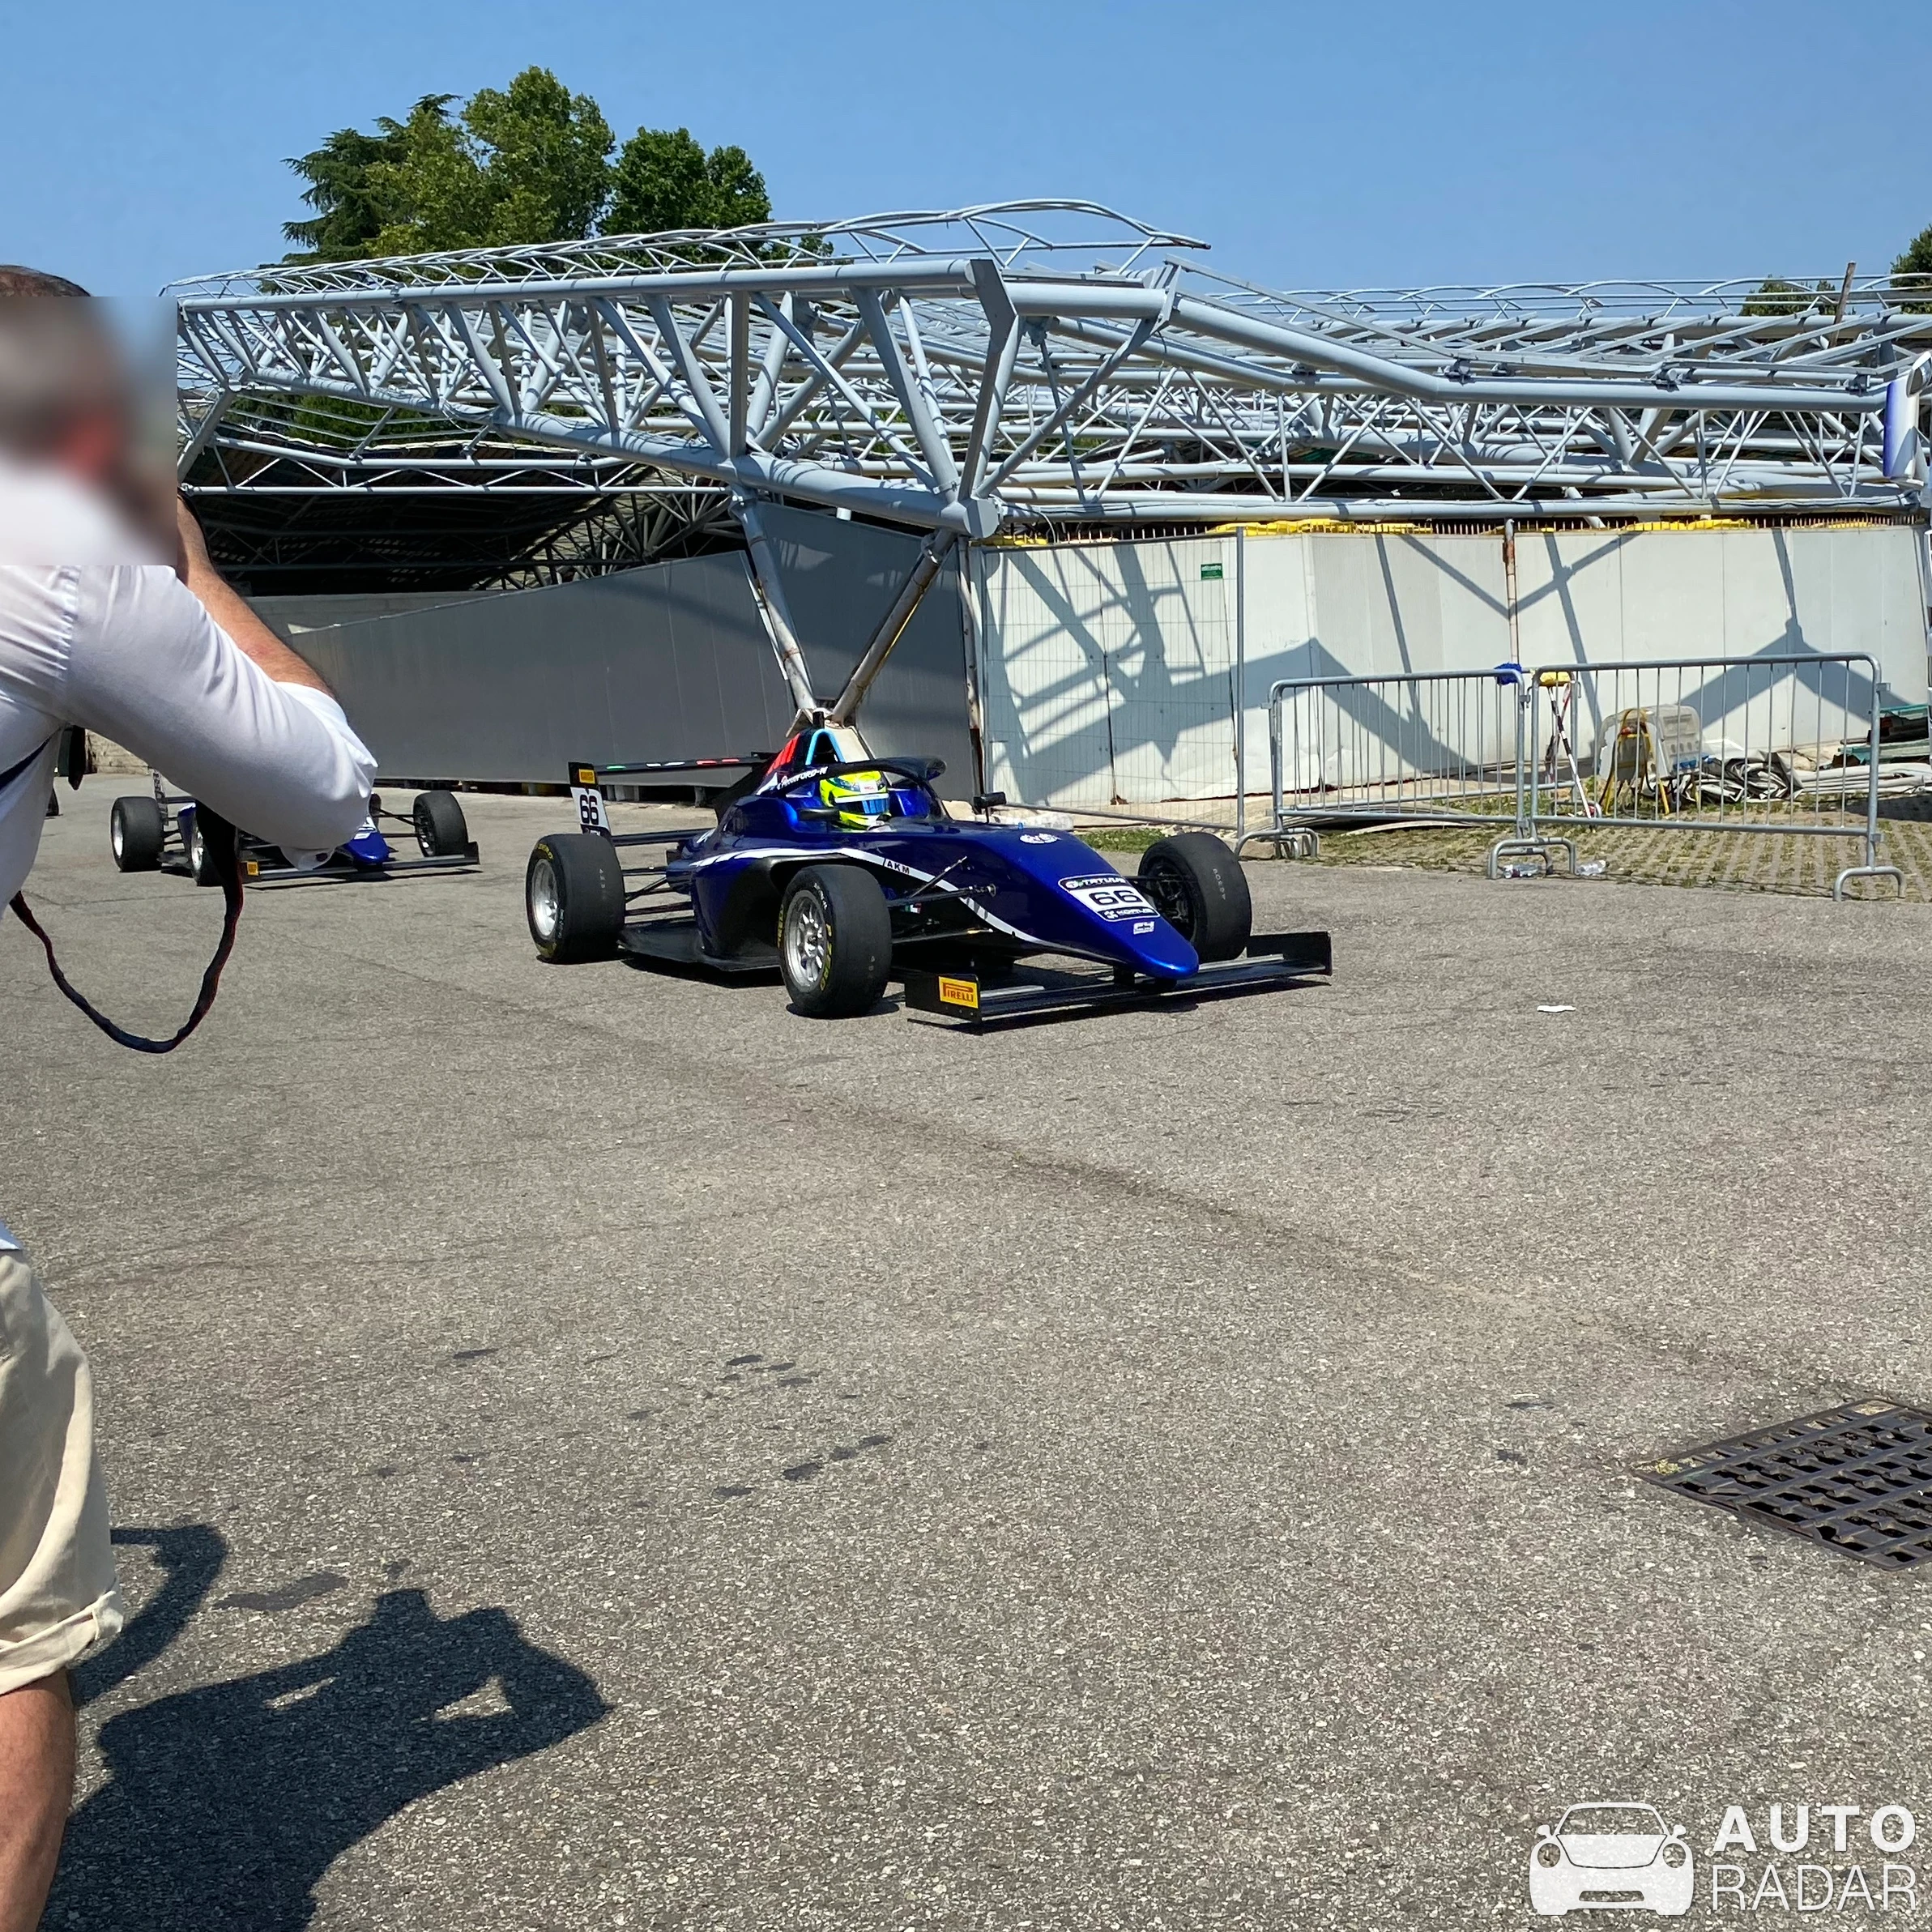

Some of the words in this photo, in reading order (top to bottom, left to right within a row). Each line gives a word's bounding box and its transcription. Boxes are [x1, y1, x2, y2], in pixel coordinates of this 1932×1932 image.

[580, 795, 599, 825] 66
[887, 860, 911, 875] AKM
[1089, 890, 1143, 906] 66
[943, 982, 974, 1003] PIRELLI
